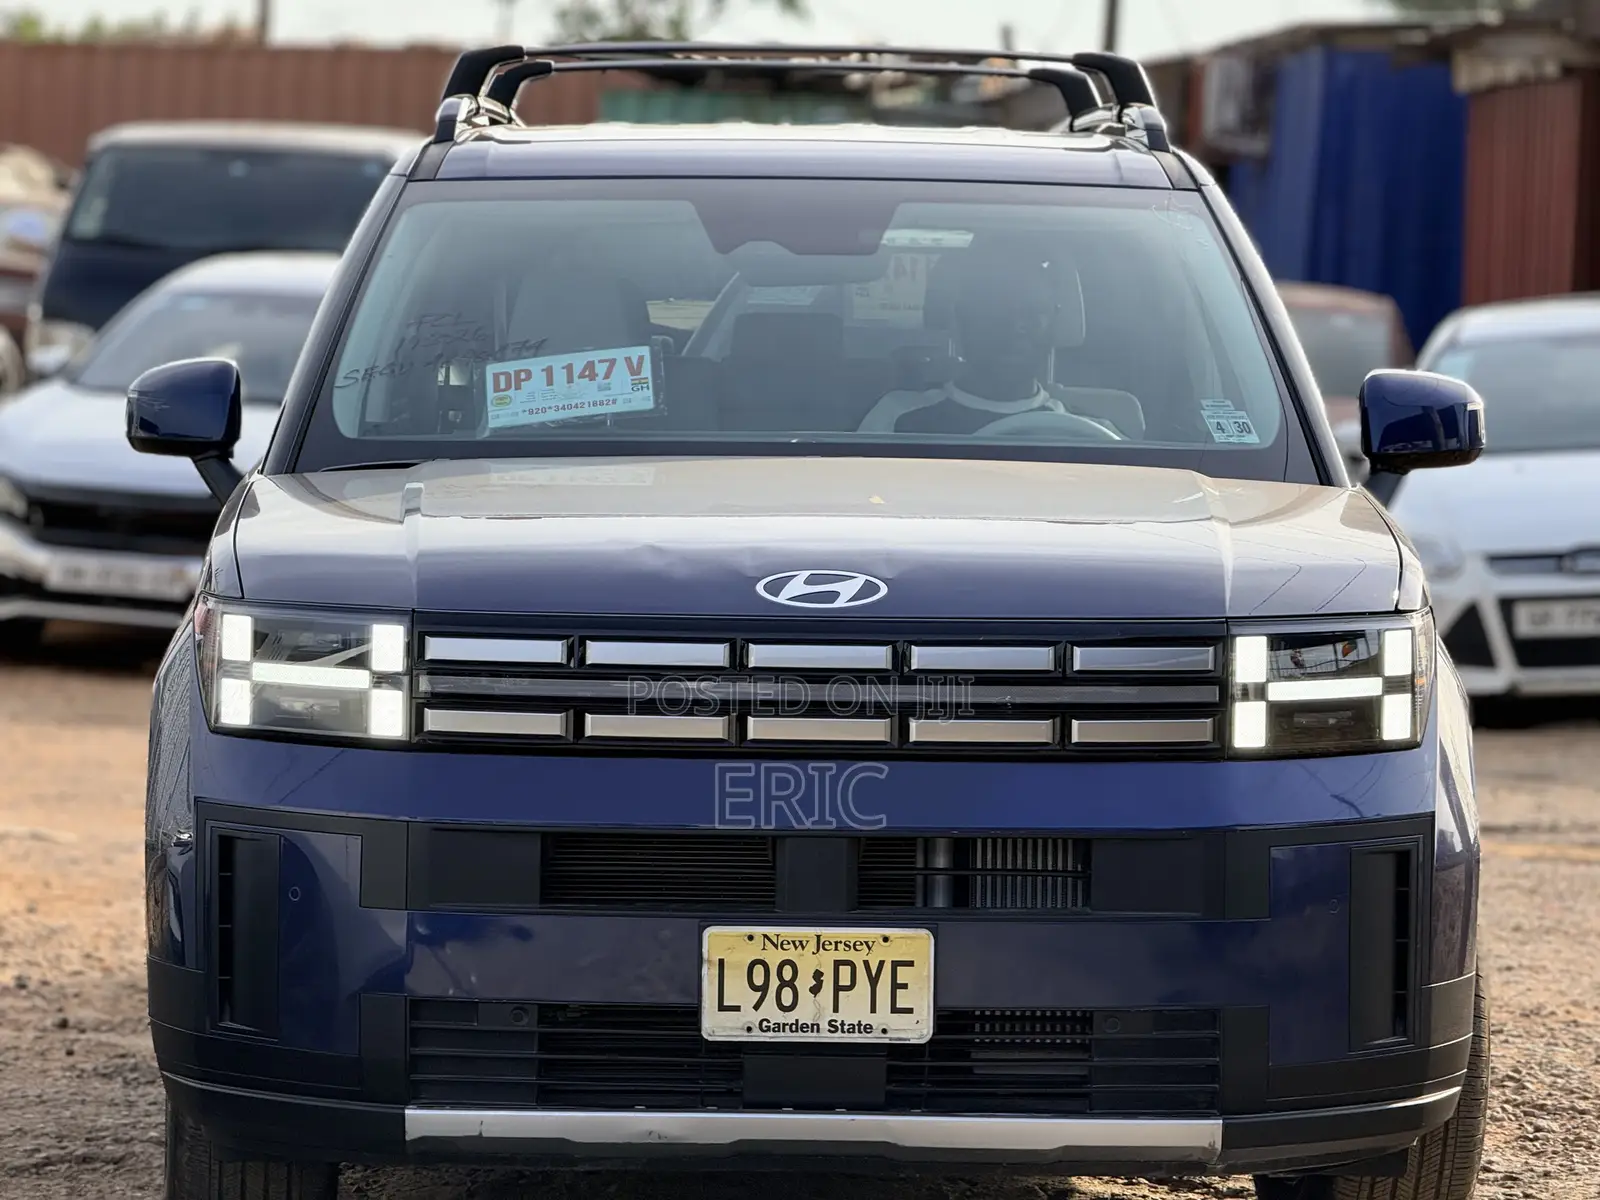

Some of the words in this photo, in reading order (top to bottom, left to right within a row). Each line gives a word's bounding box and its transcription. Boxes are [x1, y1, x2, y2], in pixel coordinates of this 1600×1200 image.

[492, 368, 532, 393] DP
[541, 358, 617, 387] 1147
[624, 355, 645, 376] V
[1216, 421, 1225, 434] 4
[1234, 421, 1251, 434] 30
[761, 934, 809, 951] New
[812, 934, 876, 955] Jersey
[717, 958, 799, 1013] L98
[832, 959, 915, 1015] PYE
[758, 1018, 820, 1034] Garden
[827, 1019, 874, 1035] State
